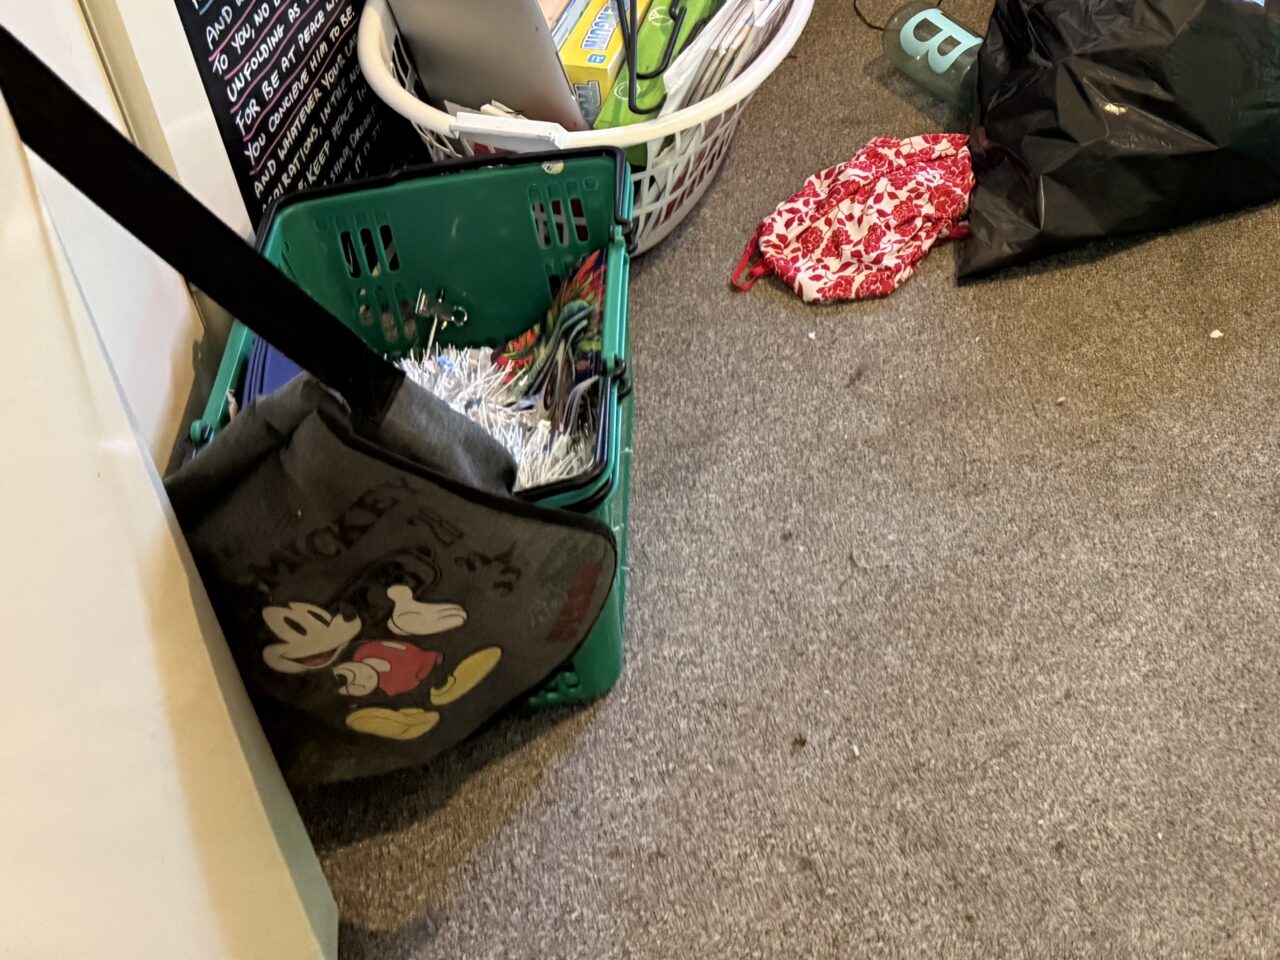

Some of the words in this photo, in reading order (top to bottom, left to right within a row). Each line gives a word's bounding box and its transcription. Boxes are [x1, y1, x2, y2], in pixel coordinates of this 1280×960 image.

[205, 5, 233, 51] AND
[212, 51, 229, 76] TO
[253, 3, 270, 26] NO
[227, 23, 285, 103] UNFOLDING
[287, 3, 301, 23] AS
[261, 69, 280, 102] BE
[281, 47, 297, 73] AT
[297, 9, 326, 54] PEACE
[900, 7, 985, 74] B
[243, 133, 267, 167] YOU
[310, 40, 329, 74] HIM
[329, 25, 341, 43] TO
[253, 159, 277, 200] AND
[277, 87, 324, 161] WHATEVER
